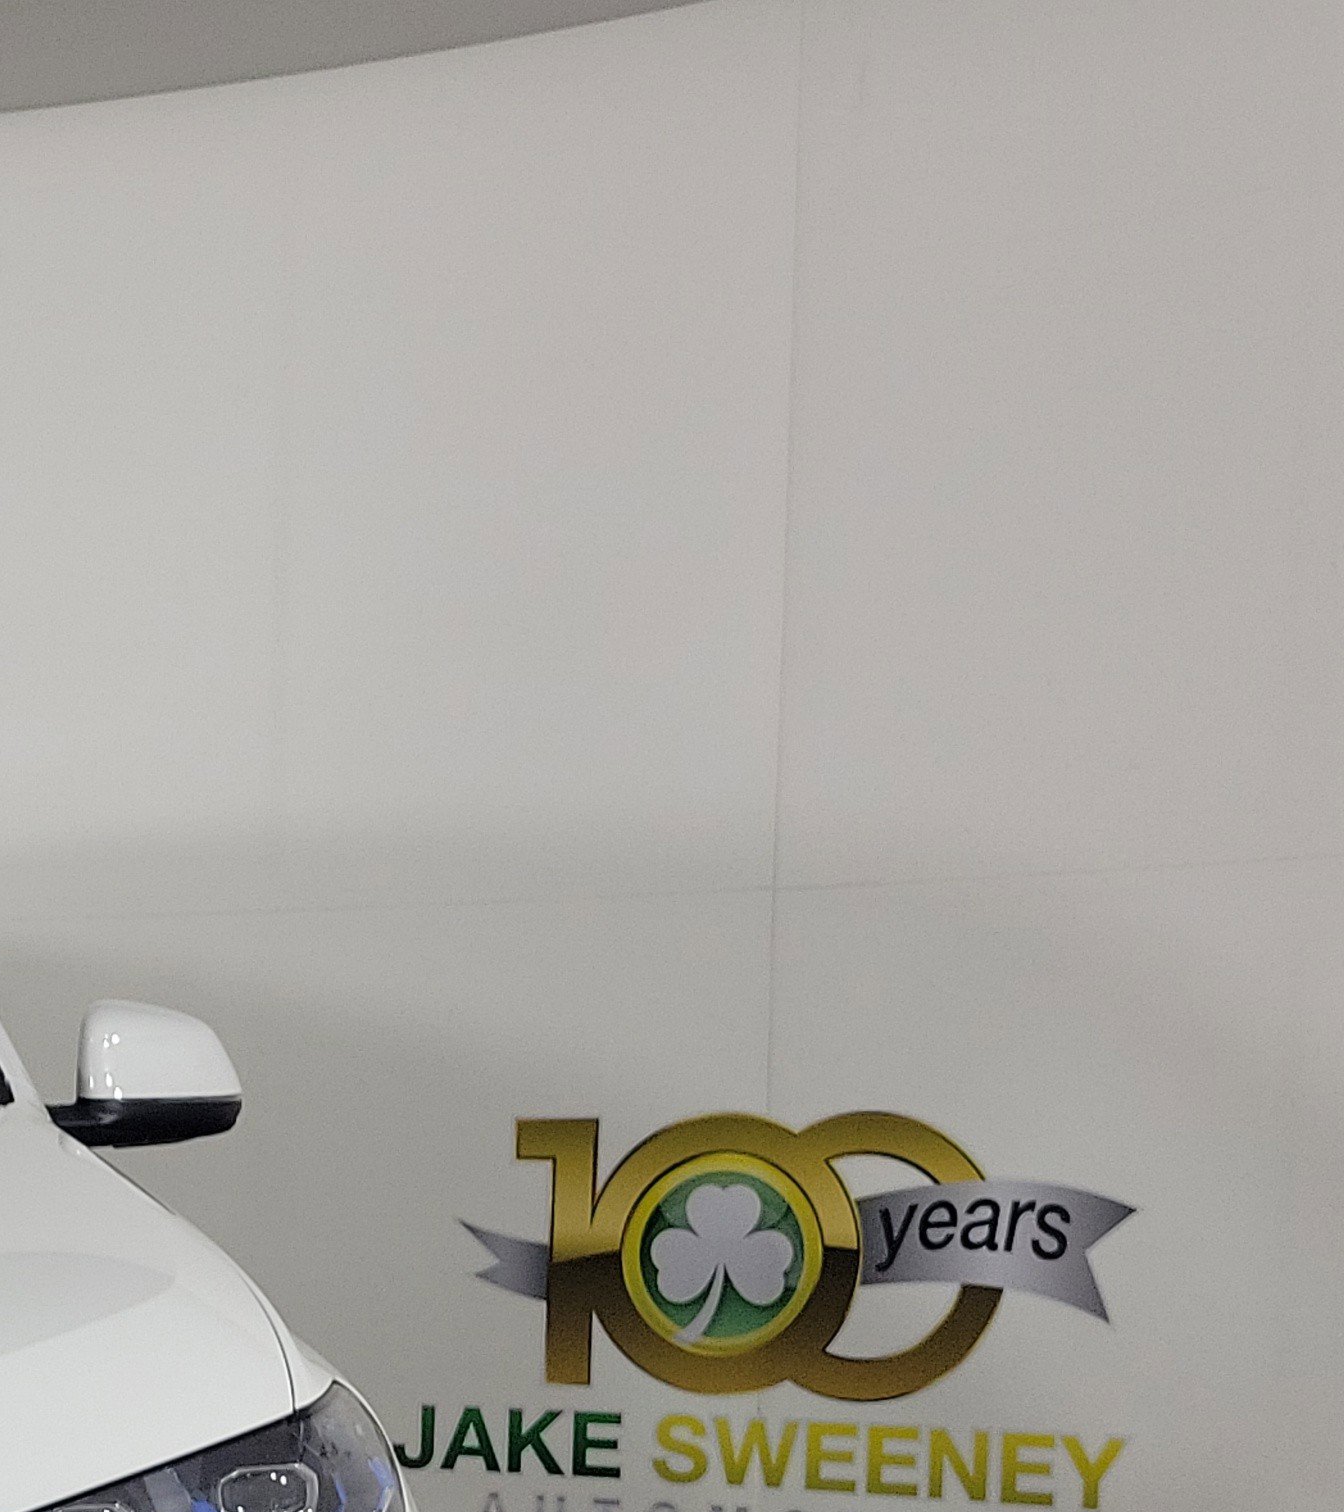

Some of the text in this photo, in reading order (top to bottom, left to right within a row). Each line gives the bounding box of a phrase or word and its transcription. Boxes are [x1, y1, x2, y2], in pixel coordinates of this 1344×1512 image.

[515, 1110, 1071, 1401] 100 years
[394, 1404, 1126, 1510] JAKE SWEENEY
